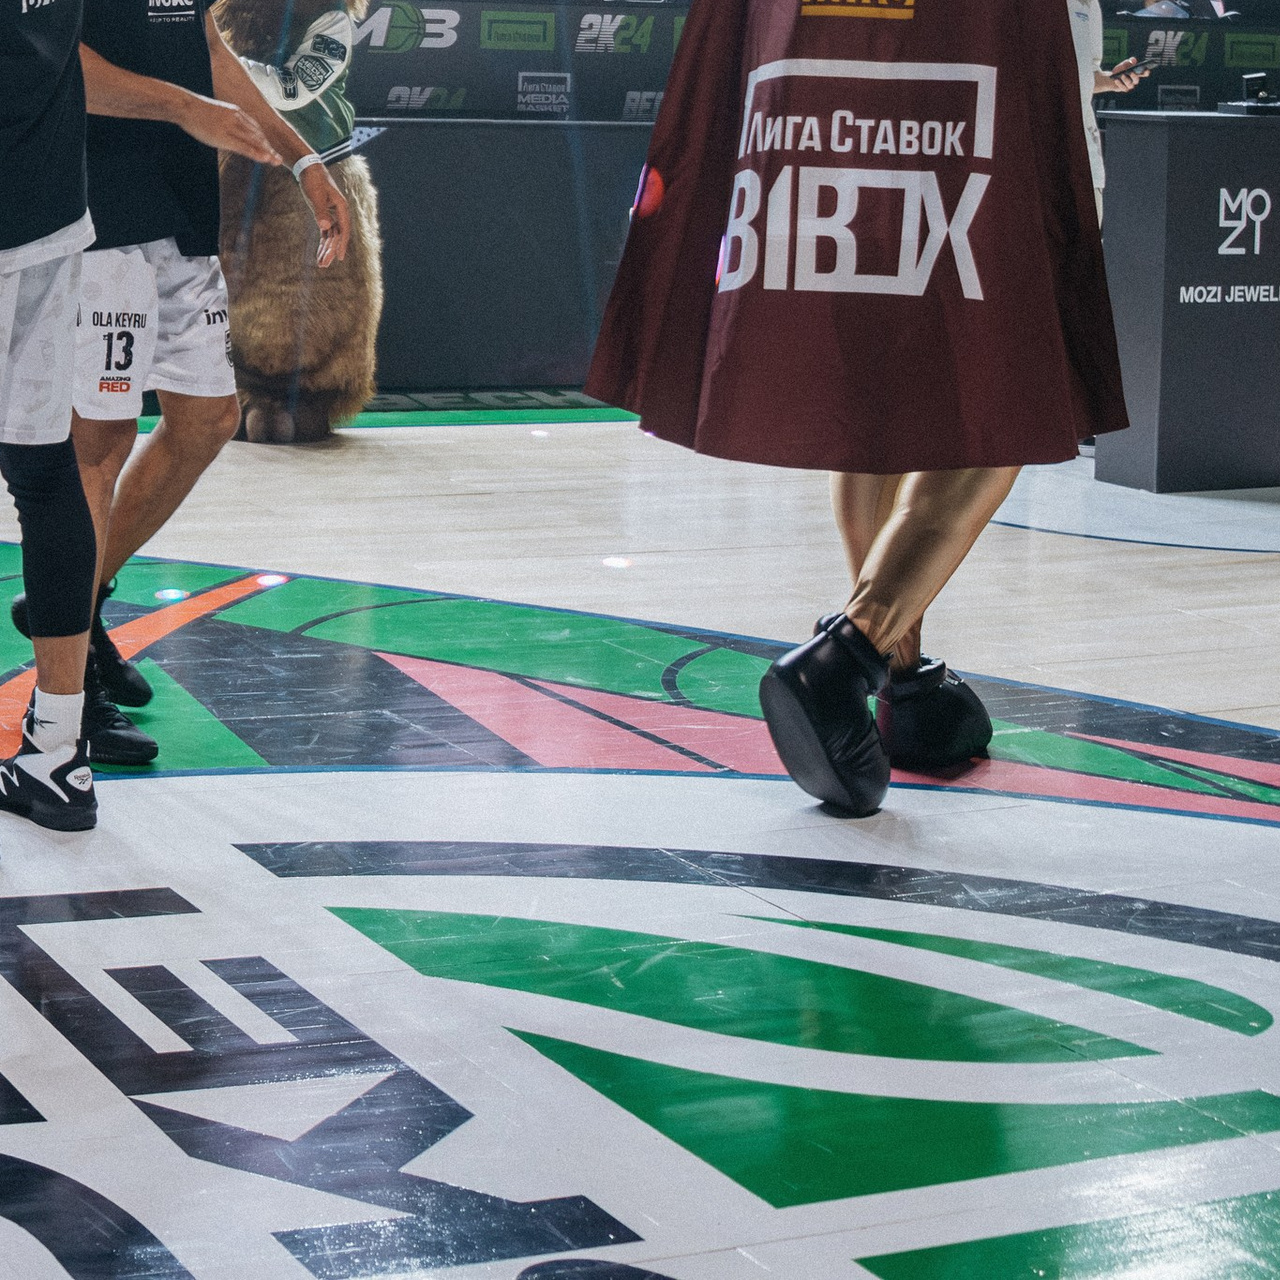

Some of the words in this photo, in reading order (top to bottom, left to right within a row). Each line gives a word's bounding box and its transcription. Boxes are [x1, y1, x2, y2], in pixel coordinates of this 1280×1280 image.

[575, 13, 655, 53] 2K24
[517, 93, 570, 103] MEDIA
[746, 113, 821, 154] ЛИГА
[829, 109, 967, 157] СТАВОК
[1179, 286, 1221, 304] MOZI
[1224, 285, 1280, 303] JEWEL
[92, 311, 113, 328] OLA
[114, 312, 148, 328] KEYRU
[103, 330, 135, 371] 13
[98, 381, 131, 393] RED
